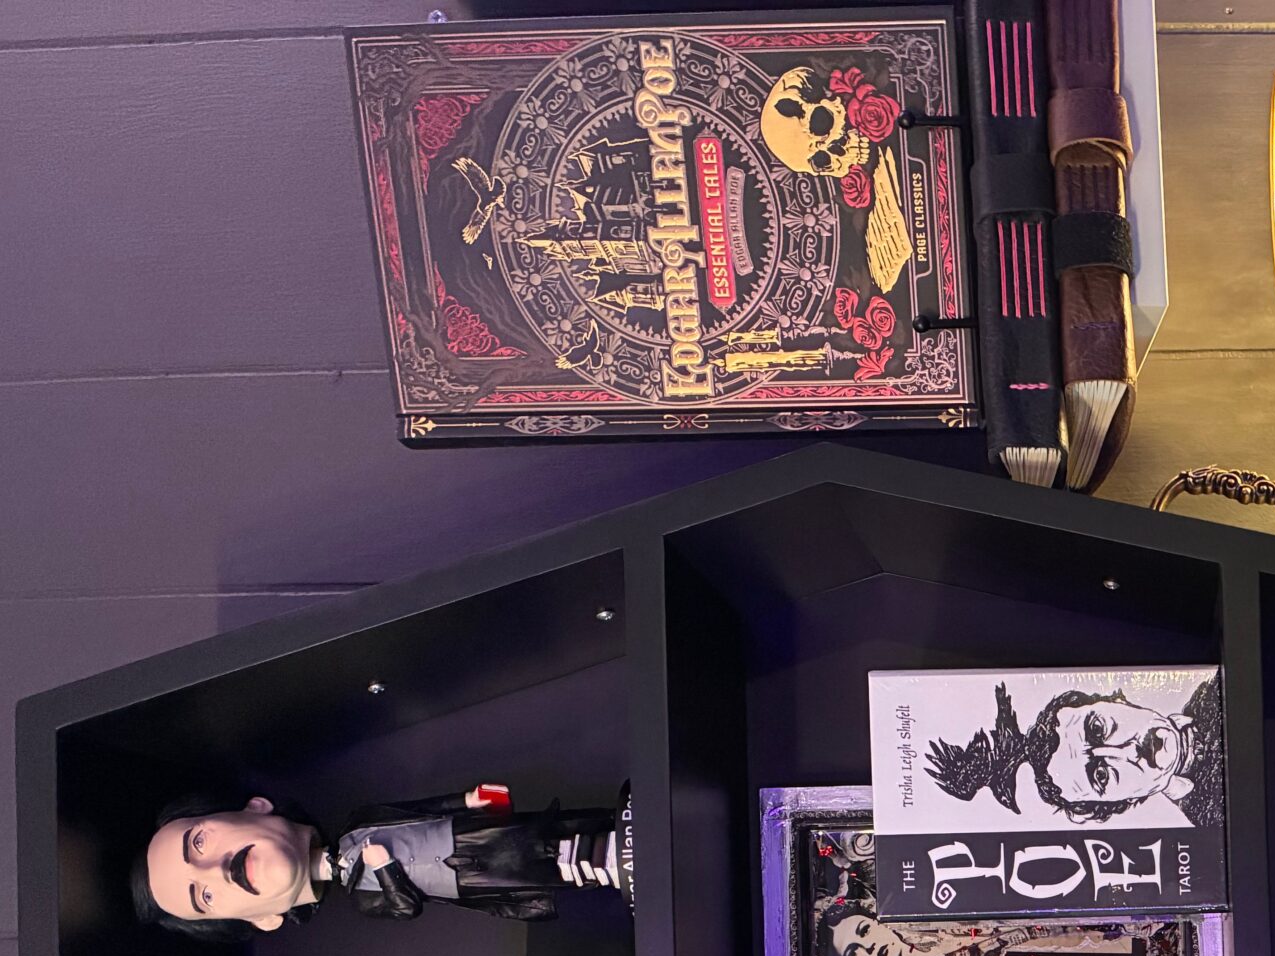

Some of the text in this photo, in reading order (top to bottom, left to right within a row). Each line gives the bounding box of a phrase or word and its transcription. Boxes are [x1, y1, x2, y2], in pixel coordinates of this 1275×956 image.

[633, 37, 716, 398] EDGAR ALLAN POE
[700, 141, 731, 298] ESSENTIAL TALES
[729, 175, 749, 269] EDGAR ALLAN POE
[912, 172, 928, 262] PAGE CLASSICS
[895, 704, 918, 808] Trisha Leigh Shufelt
[902, 860, 916, 892] THE
[926, 838, 1164, 910] POE
[1177, 841, 1191, 896] TAROT
